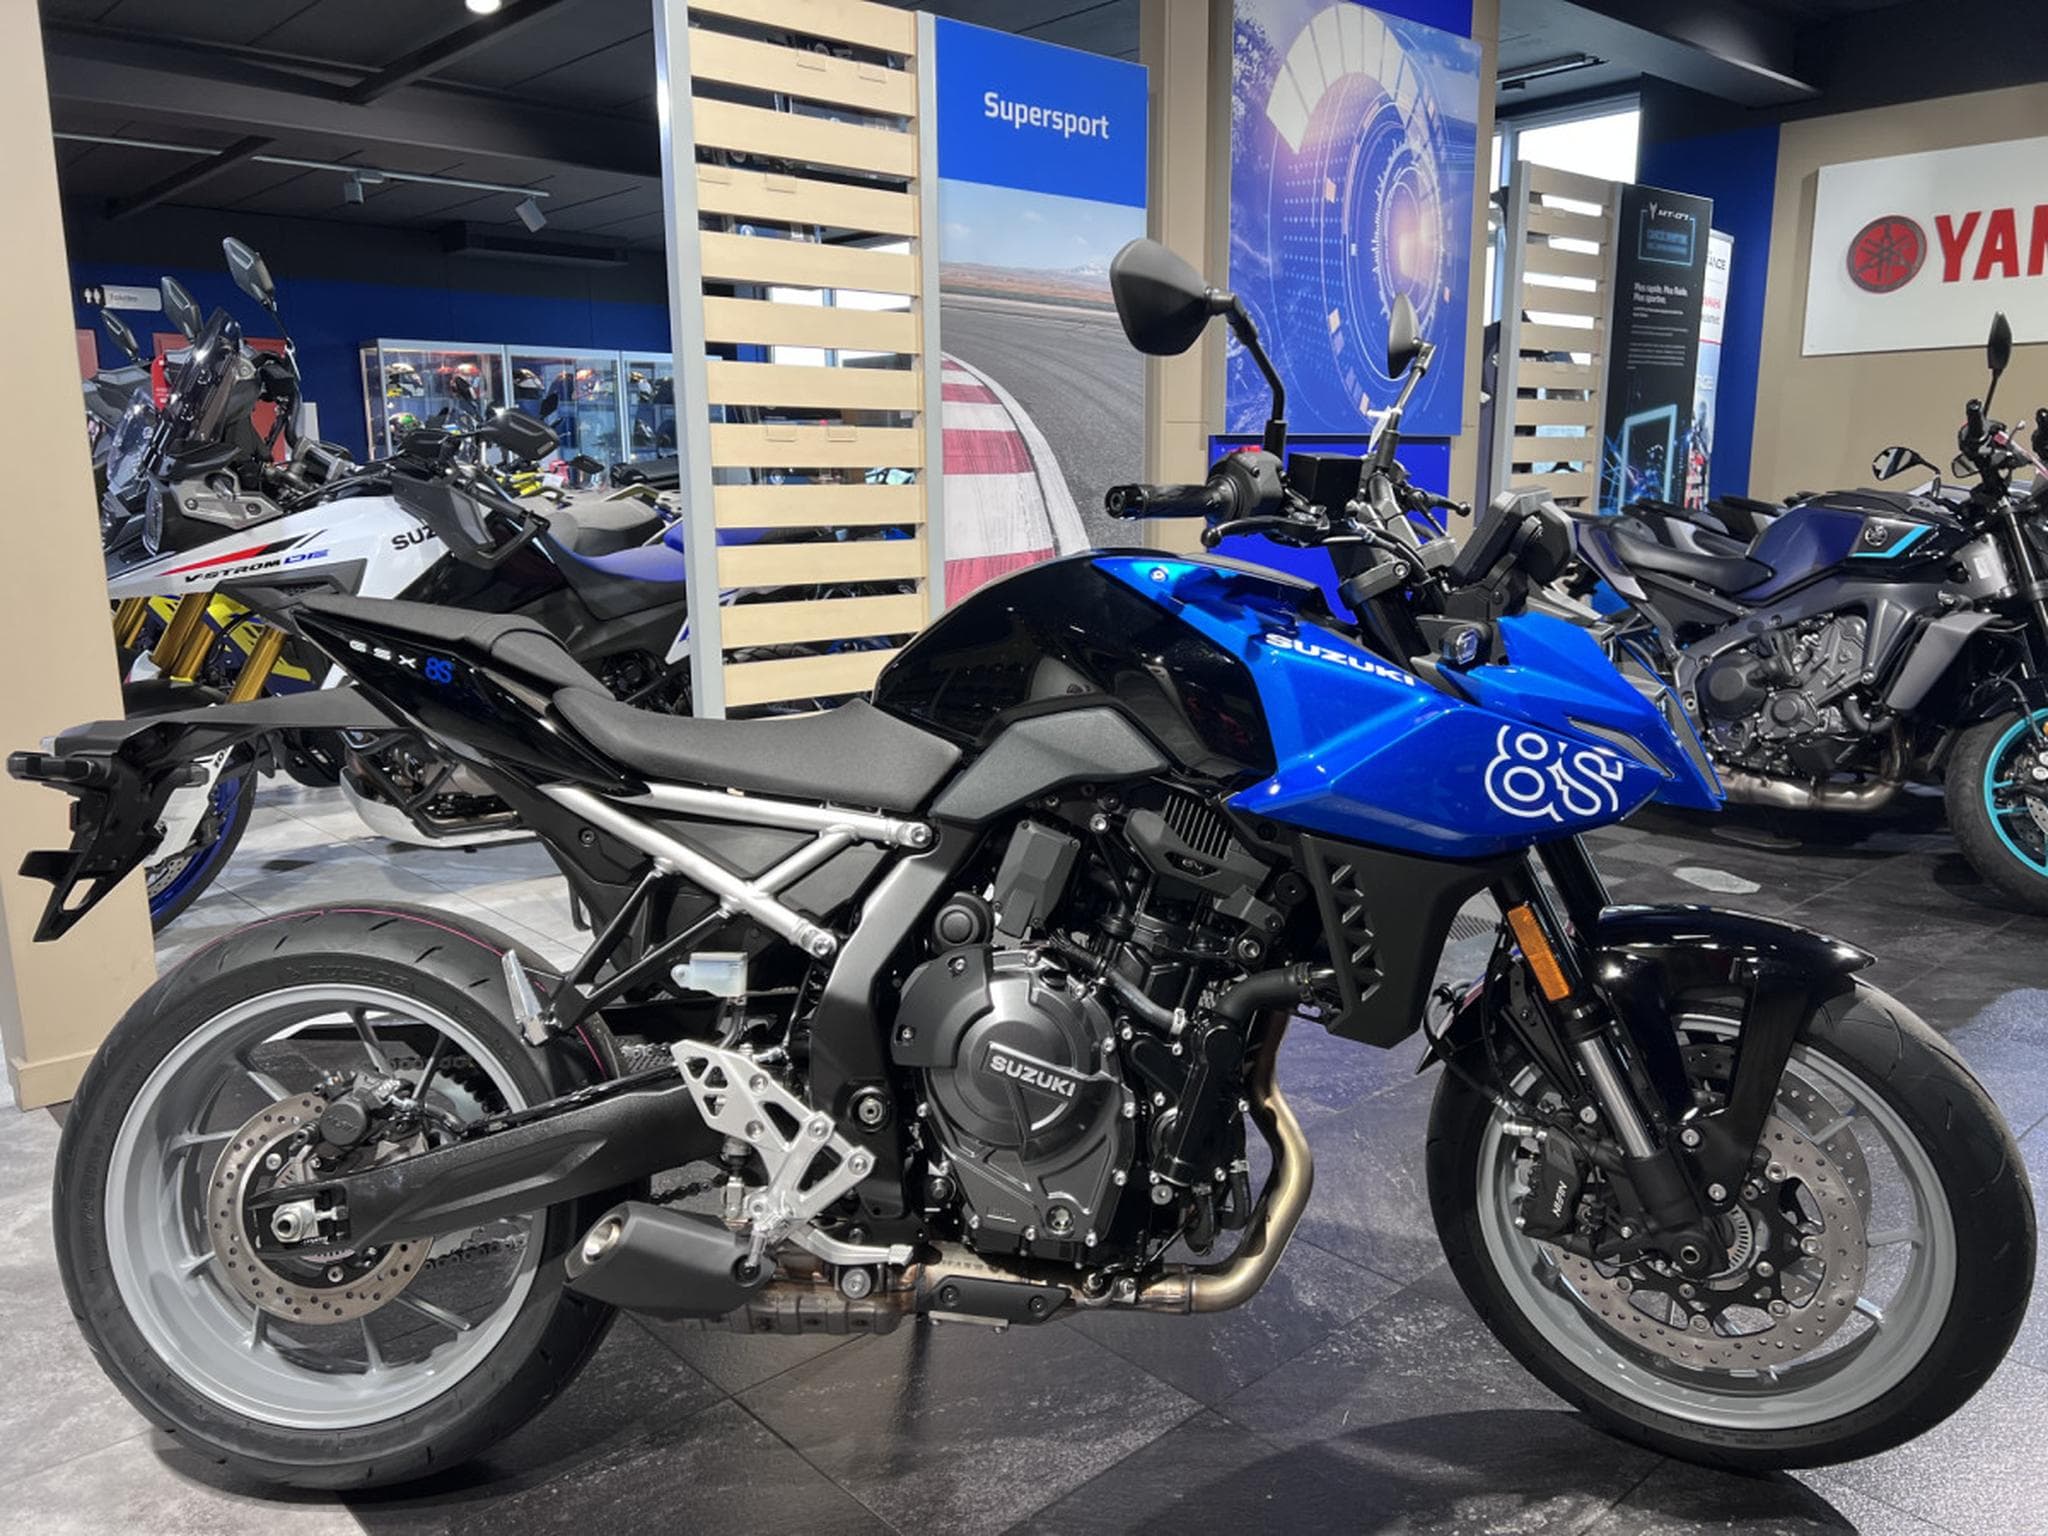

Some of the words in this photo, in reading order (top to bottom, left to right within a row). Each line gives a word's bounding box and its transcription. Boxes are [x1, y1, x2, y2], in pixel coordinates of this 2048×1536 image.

[984, 91, 1109, 139] Supersport
[424, 656, 455, 684] 8S
[1265, 633, 1415, 687] SUZUKI
[990, 1055, 1076, 1097] SUZUKI
